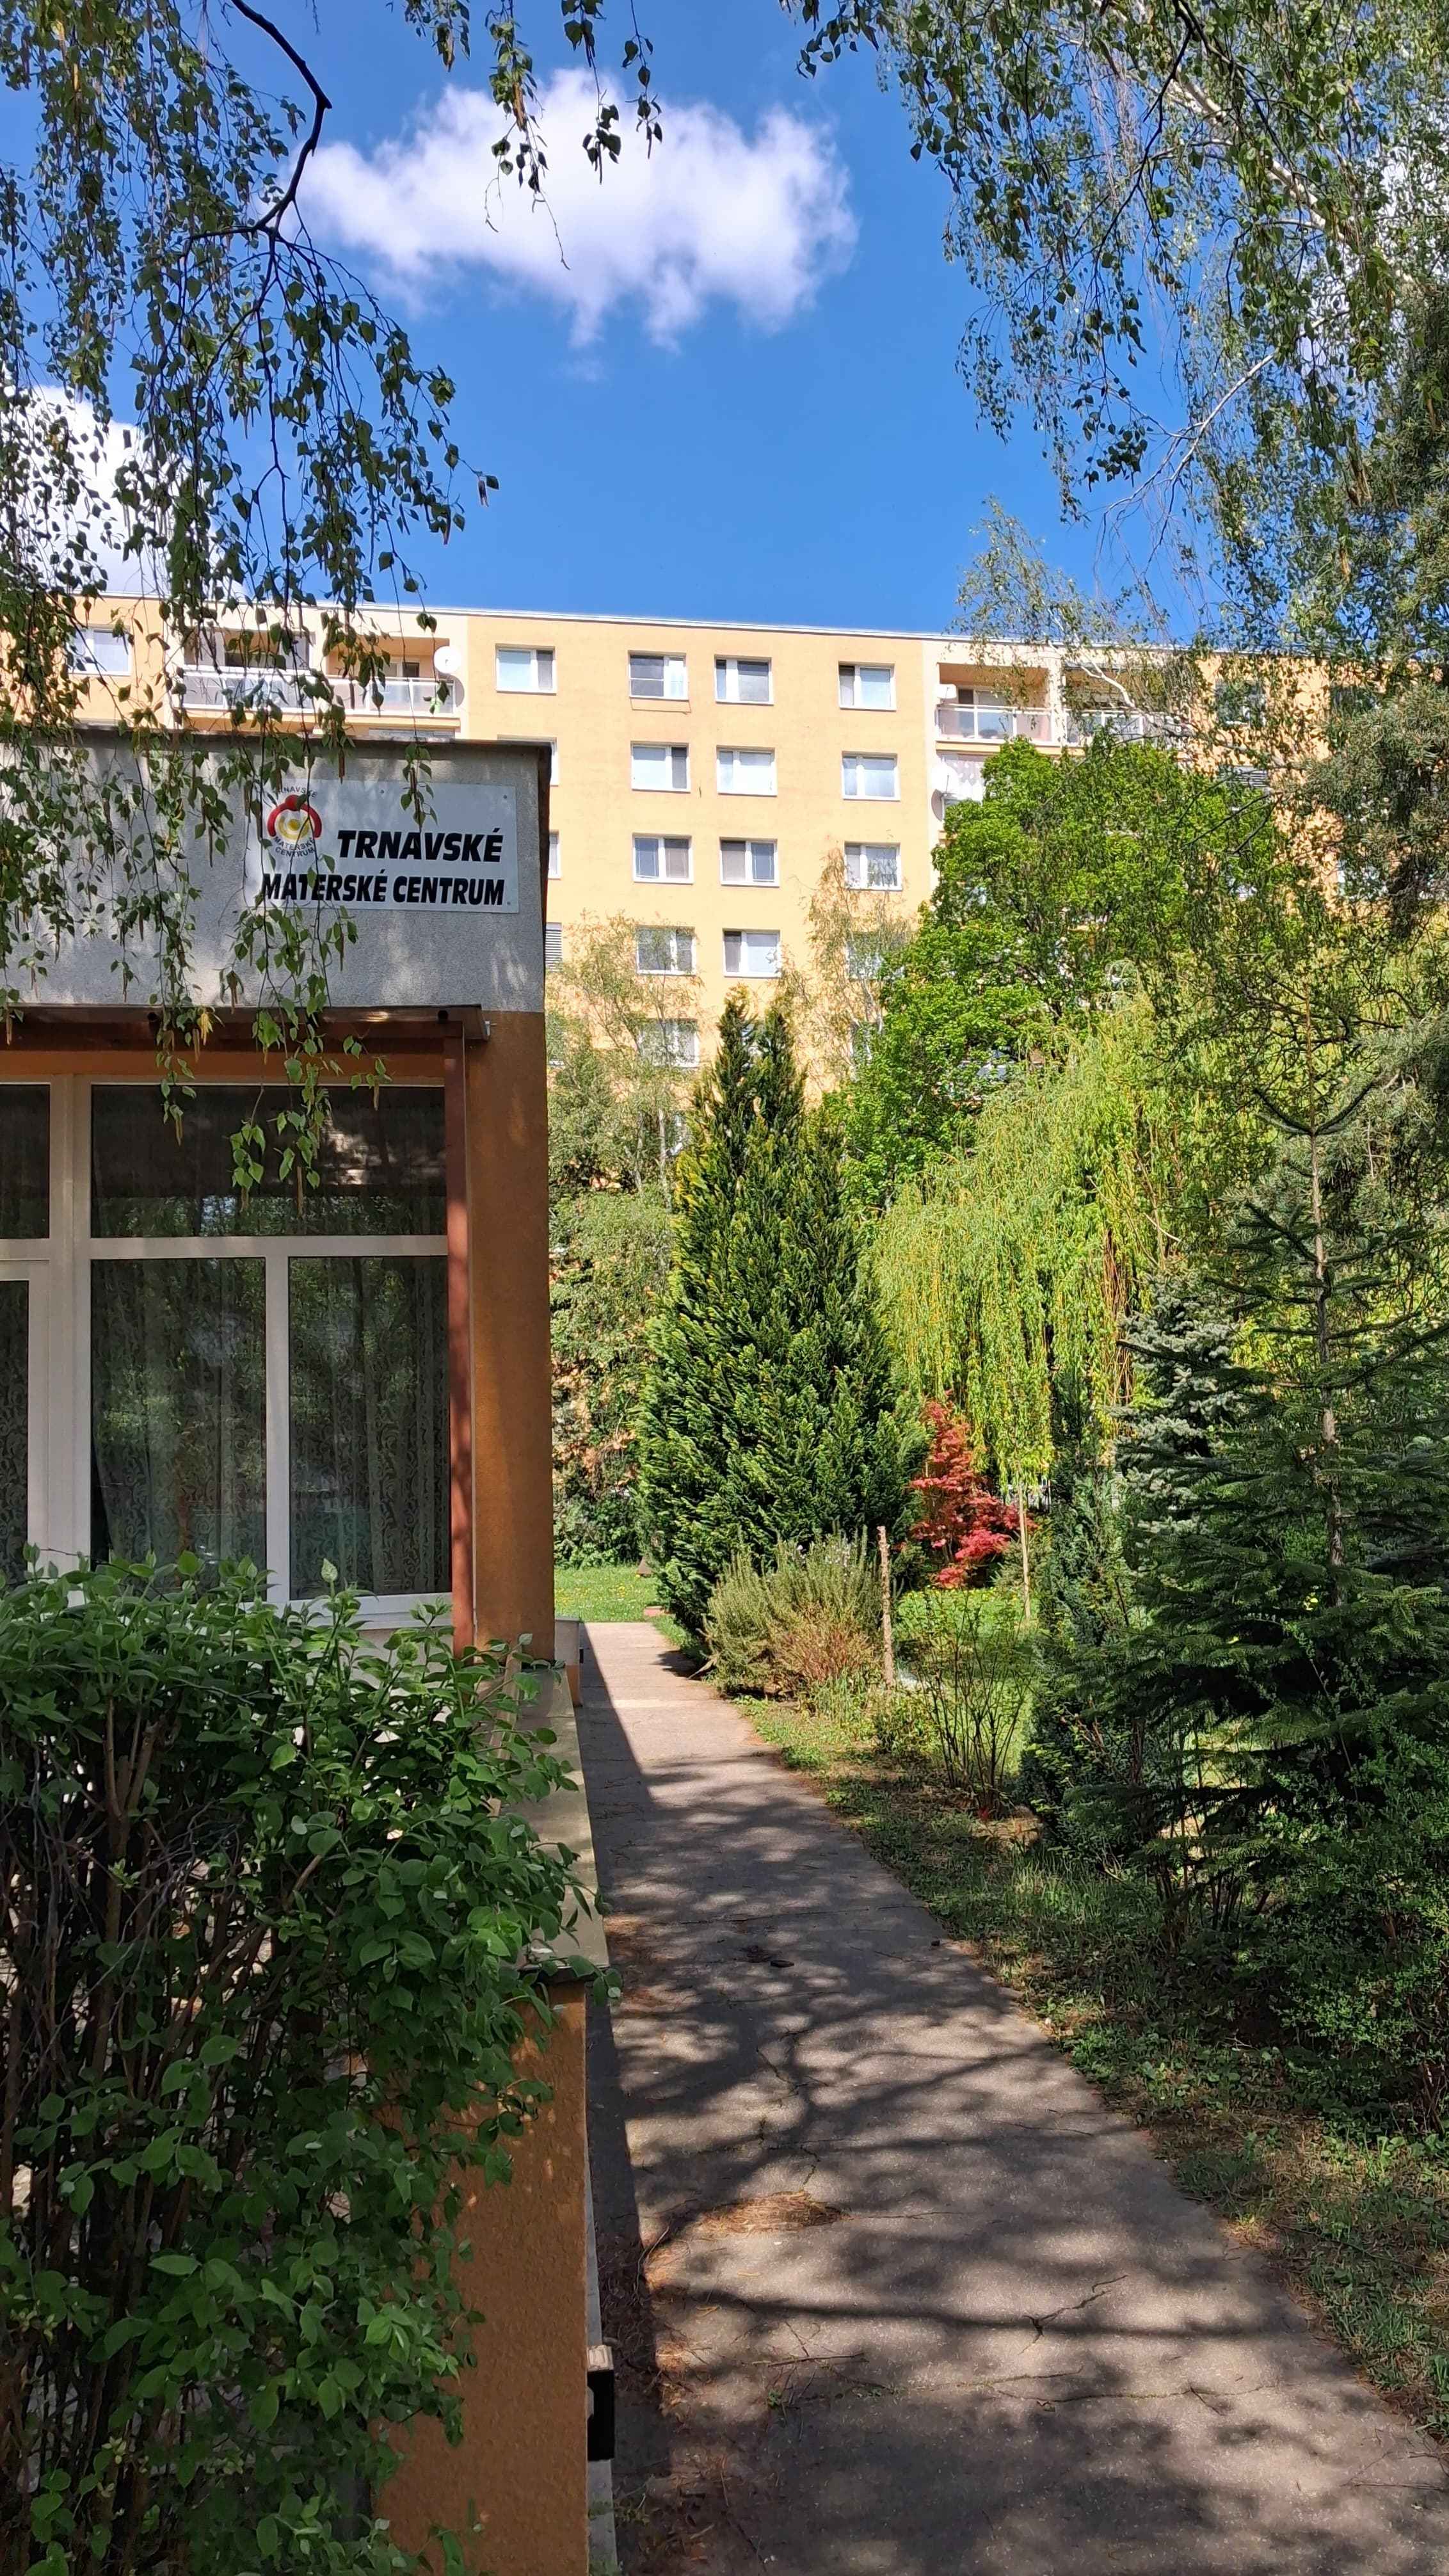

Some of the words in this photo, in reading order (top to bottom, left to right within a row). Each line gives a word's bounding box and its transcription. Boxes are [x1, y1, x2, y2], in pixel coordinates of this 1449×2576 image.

[275, 847, 314, 857] CENTRUM
[337, 828, 504, 863] TRNAVSKÉ
[263, 869, 388, 902] MATERSKÉ
[392, 876, 505, 906] CENTRUM
